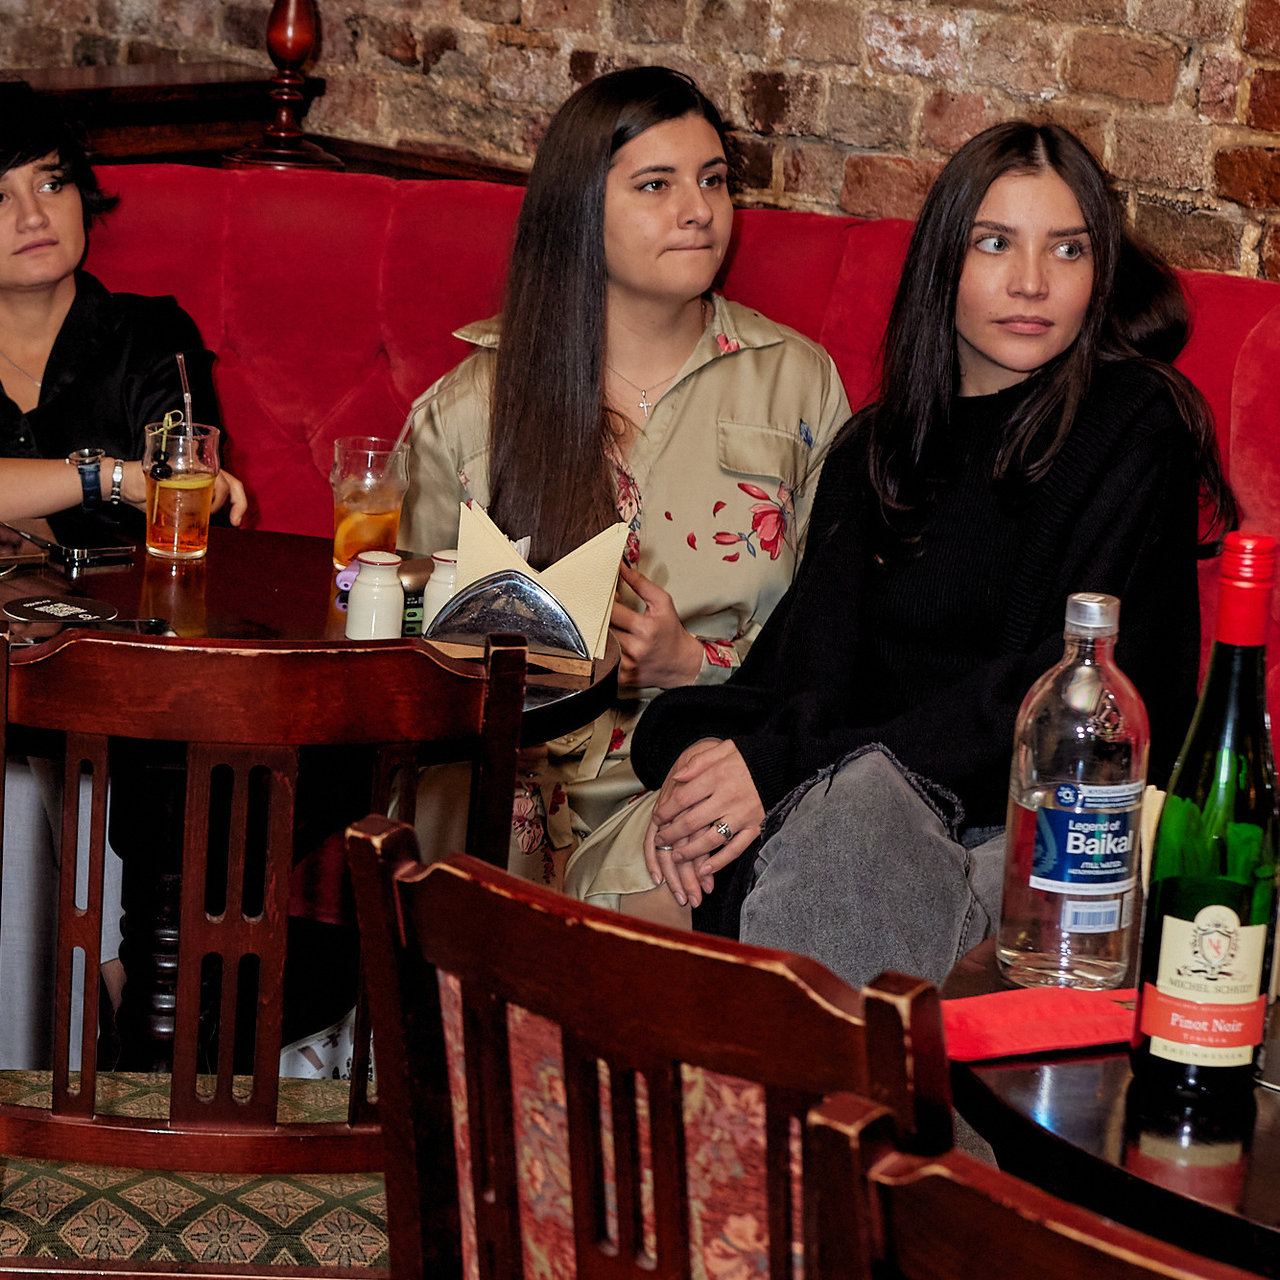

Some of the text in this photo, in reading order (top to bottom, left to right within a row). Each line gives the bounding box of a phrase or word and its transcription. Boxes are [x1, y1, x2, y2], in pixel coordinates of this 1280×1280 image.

[1068, 819, 1121, 834] Legend of
[1065, 829, 1135, 856] Baikal
[1170, 1011, 1244, 1033] Pinot Noir
